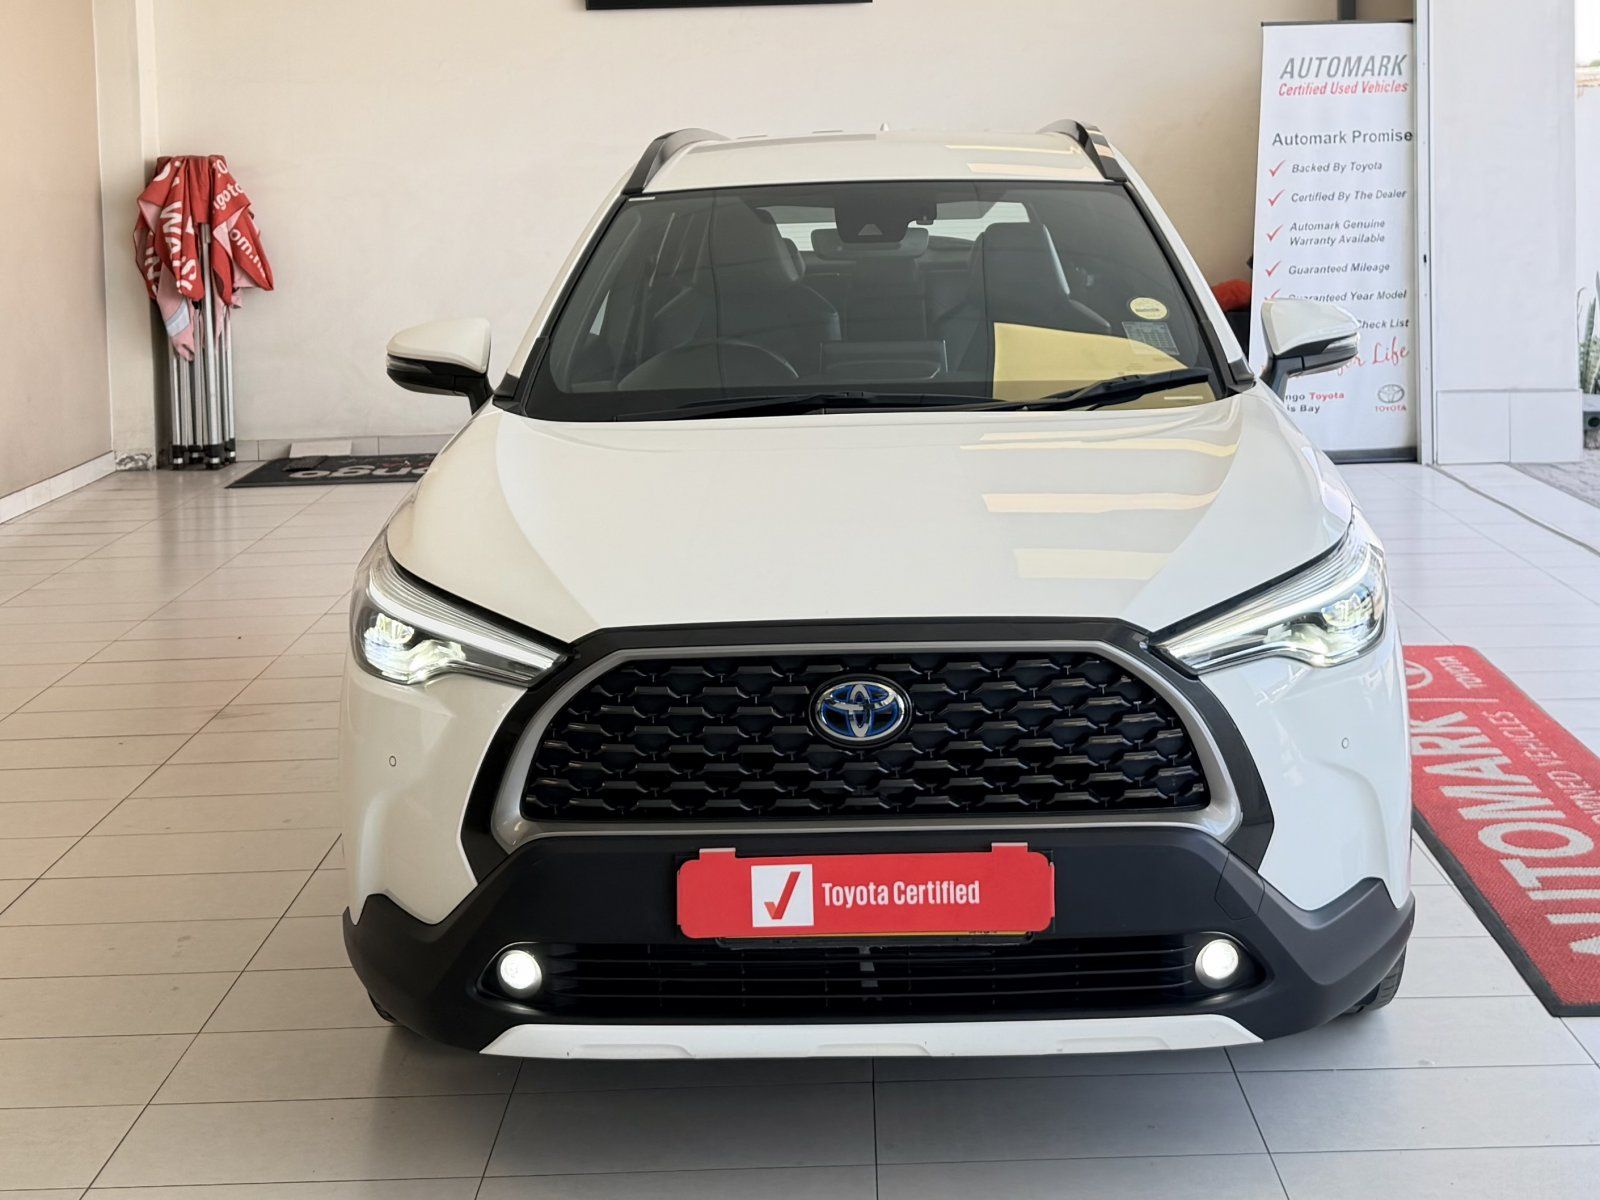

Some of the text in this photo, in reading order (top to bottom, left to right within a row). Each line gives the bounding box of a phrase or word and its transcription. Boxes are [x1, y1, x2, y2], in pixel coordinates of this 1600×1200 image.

[1279, 54, 1407, 79] AUTOMARK
[1279, 80, 1408, 96] Certified Used Vehicles
[1272, 129, 1413, 146] Automark Promise
[1291, 161, 1382, 174] Backed By Toyota
[1291, 189, 1407, 203] Certified By The Dealer
[1289, 219, 1385, 231] Automark Genuine
[1289, 233, 1385, 247] Warranty Available
[1288, 262, 1390, 275] Guaranteed Mileage
[1350, 291, 1373, 300] Year
[1376, 289, 1407, 300] Model
[1390, 318, 1410, 328] List
[1372, 336, 1410, 366] Life
[1309, 391, 1345, 402] Toyota
[1299, 403, 1321, 414] Bay
[1482, 710, 1568, 767] VEHICLES
[1410, 711, 1600, 955] UTOMARK
[821, 880, 980, 909] Toyota Certified
